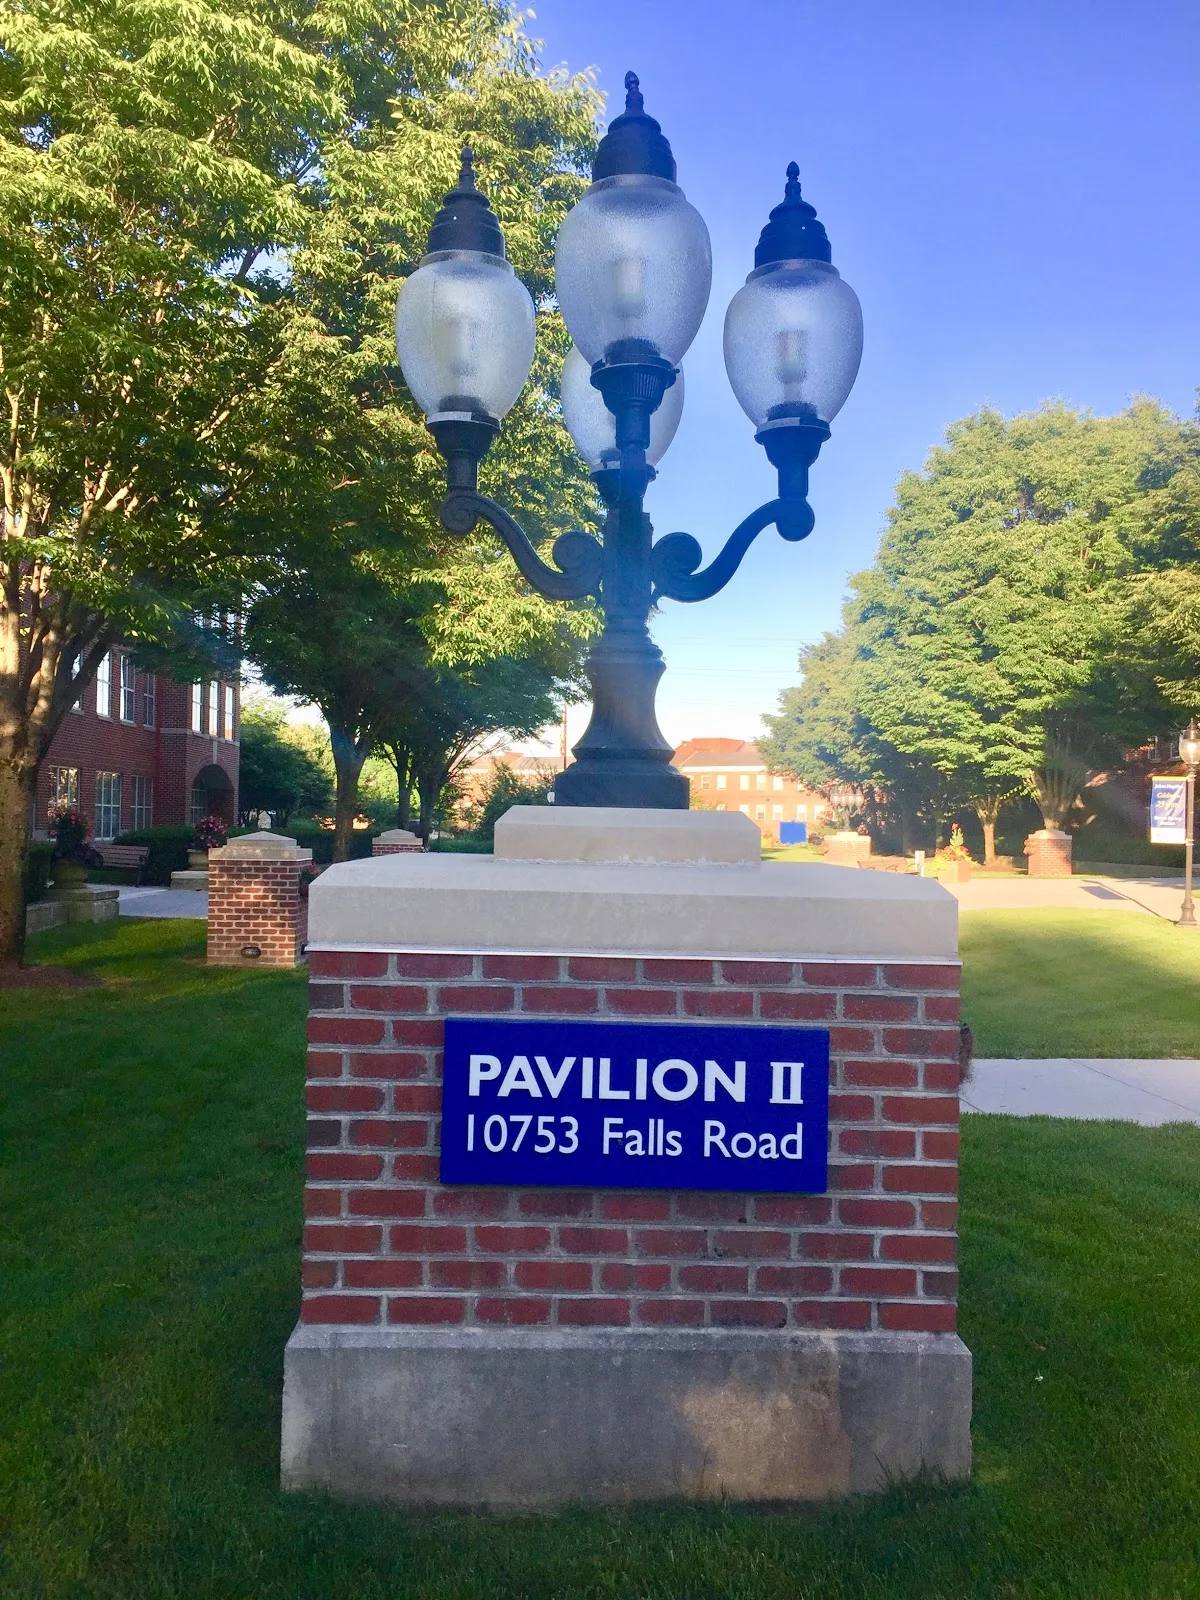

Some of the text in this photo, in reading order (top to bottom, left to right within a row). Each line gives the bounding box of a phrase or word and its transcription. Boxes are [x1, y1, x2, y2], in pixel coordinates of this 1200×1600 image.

[468, 1054, 805, 1105] PAVILION II
[467, 1114, 803, 1160] 10753 Falls Road
